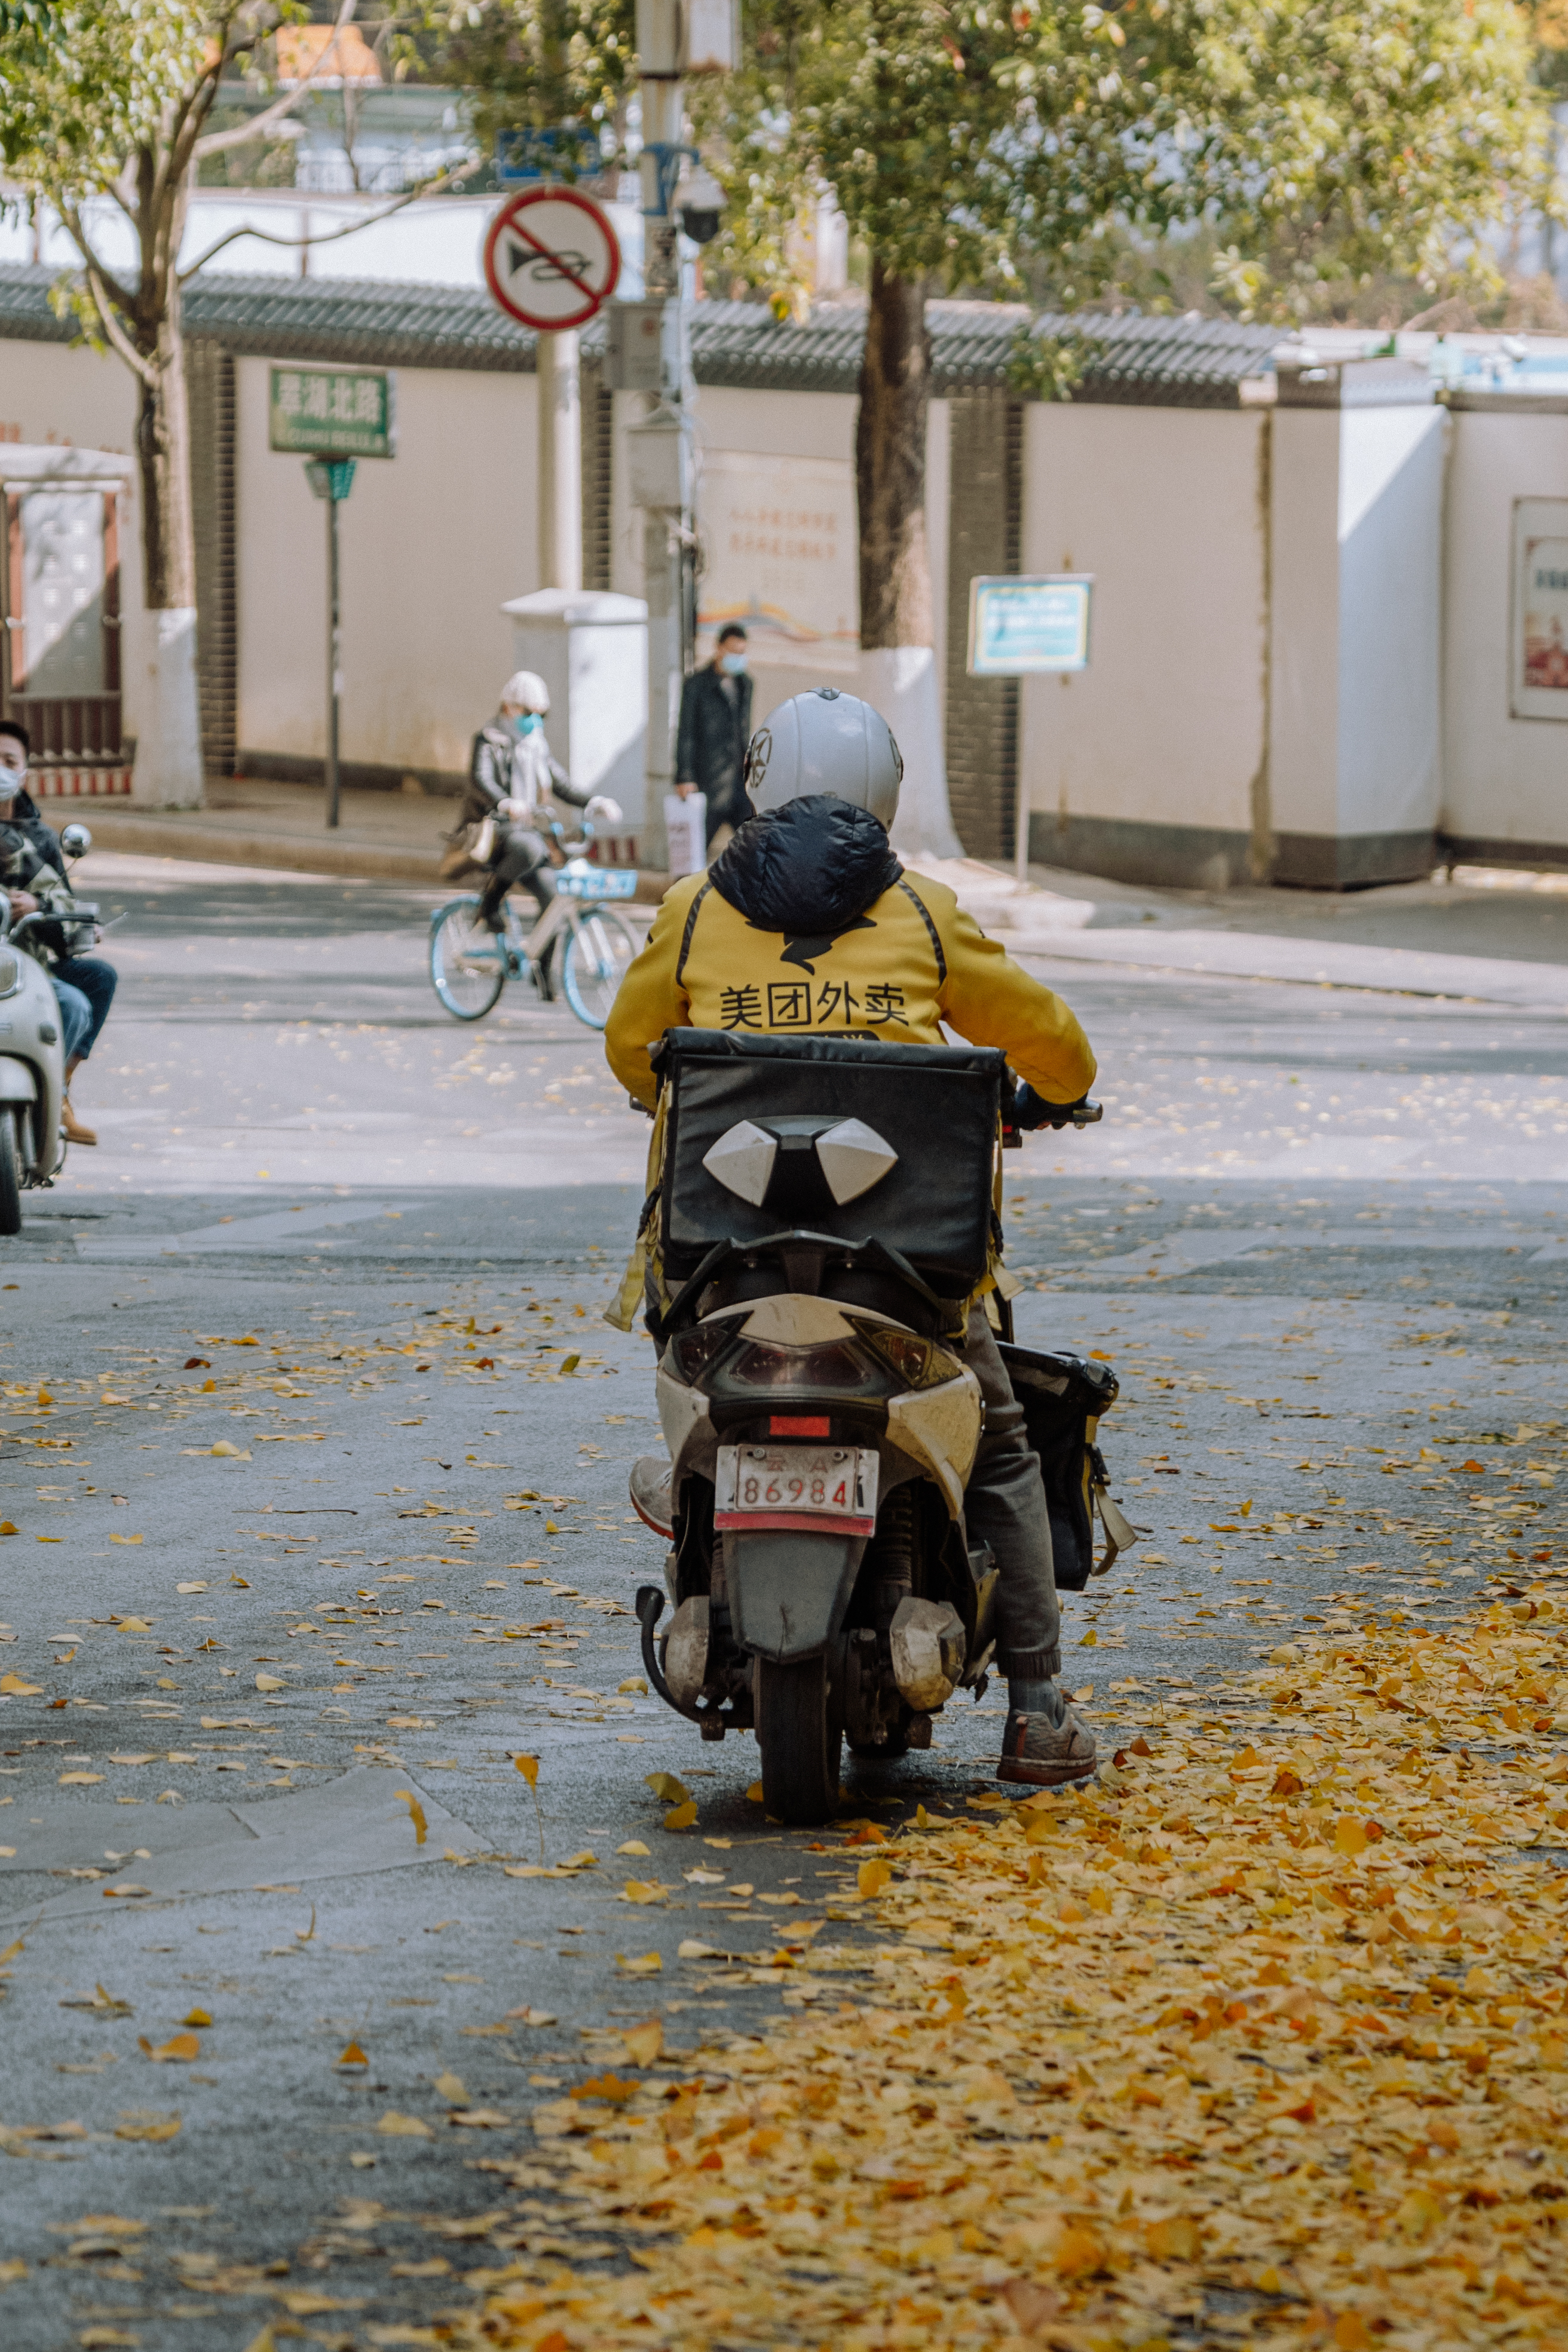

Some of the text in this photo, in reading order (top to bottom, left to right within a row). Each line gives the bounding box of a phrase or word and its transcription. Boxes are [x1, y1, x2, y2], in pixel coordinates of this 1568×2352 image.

[719, 981, 909, 1031] 美团外卖
[745, 1475, 846, 1506] 86984
